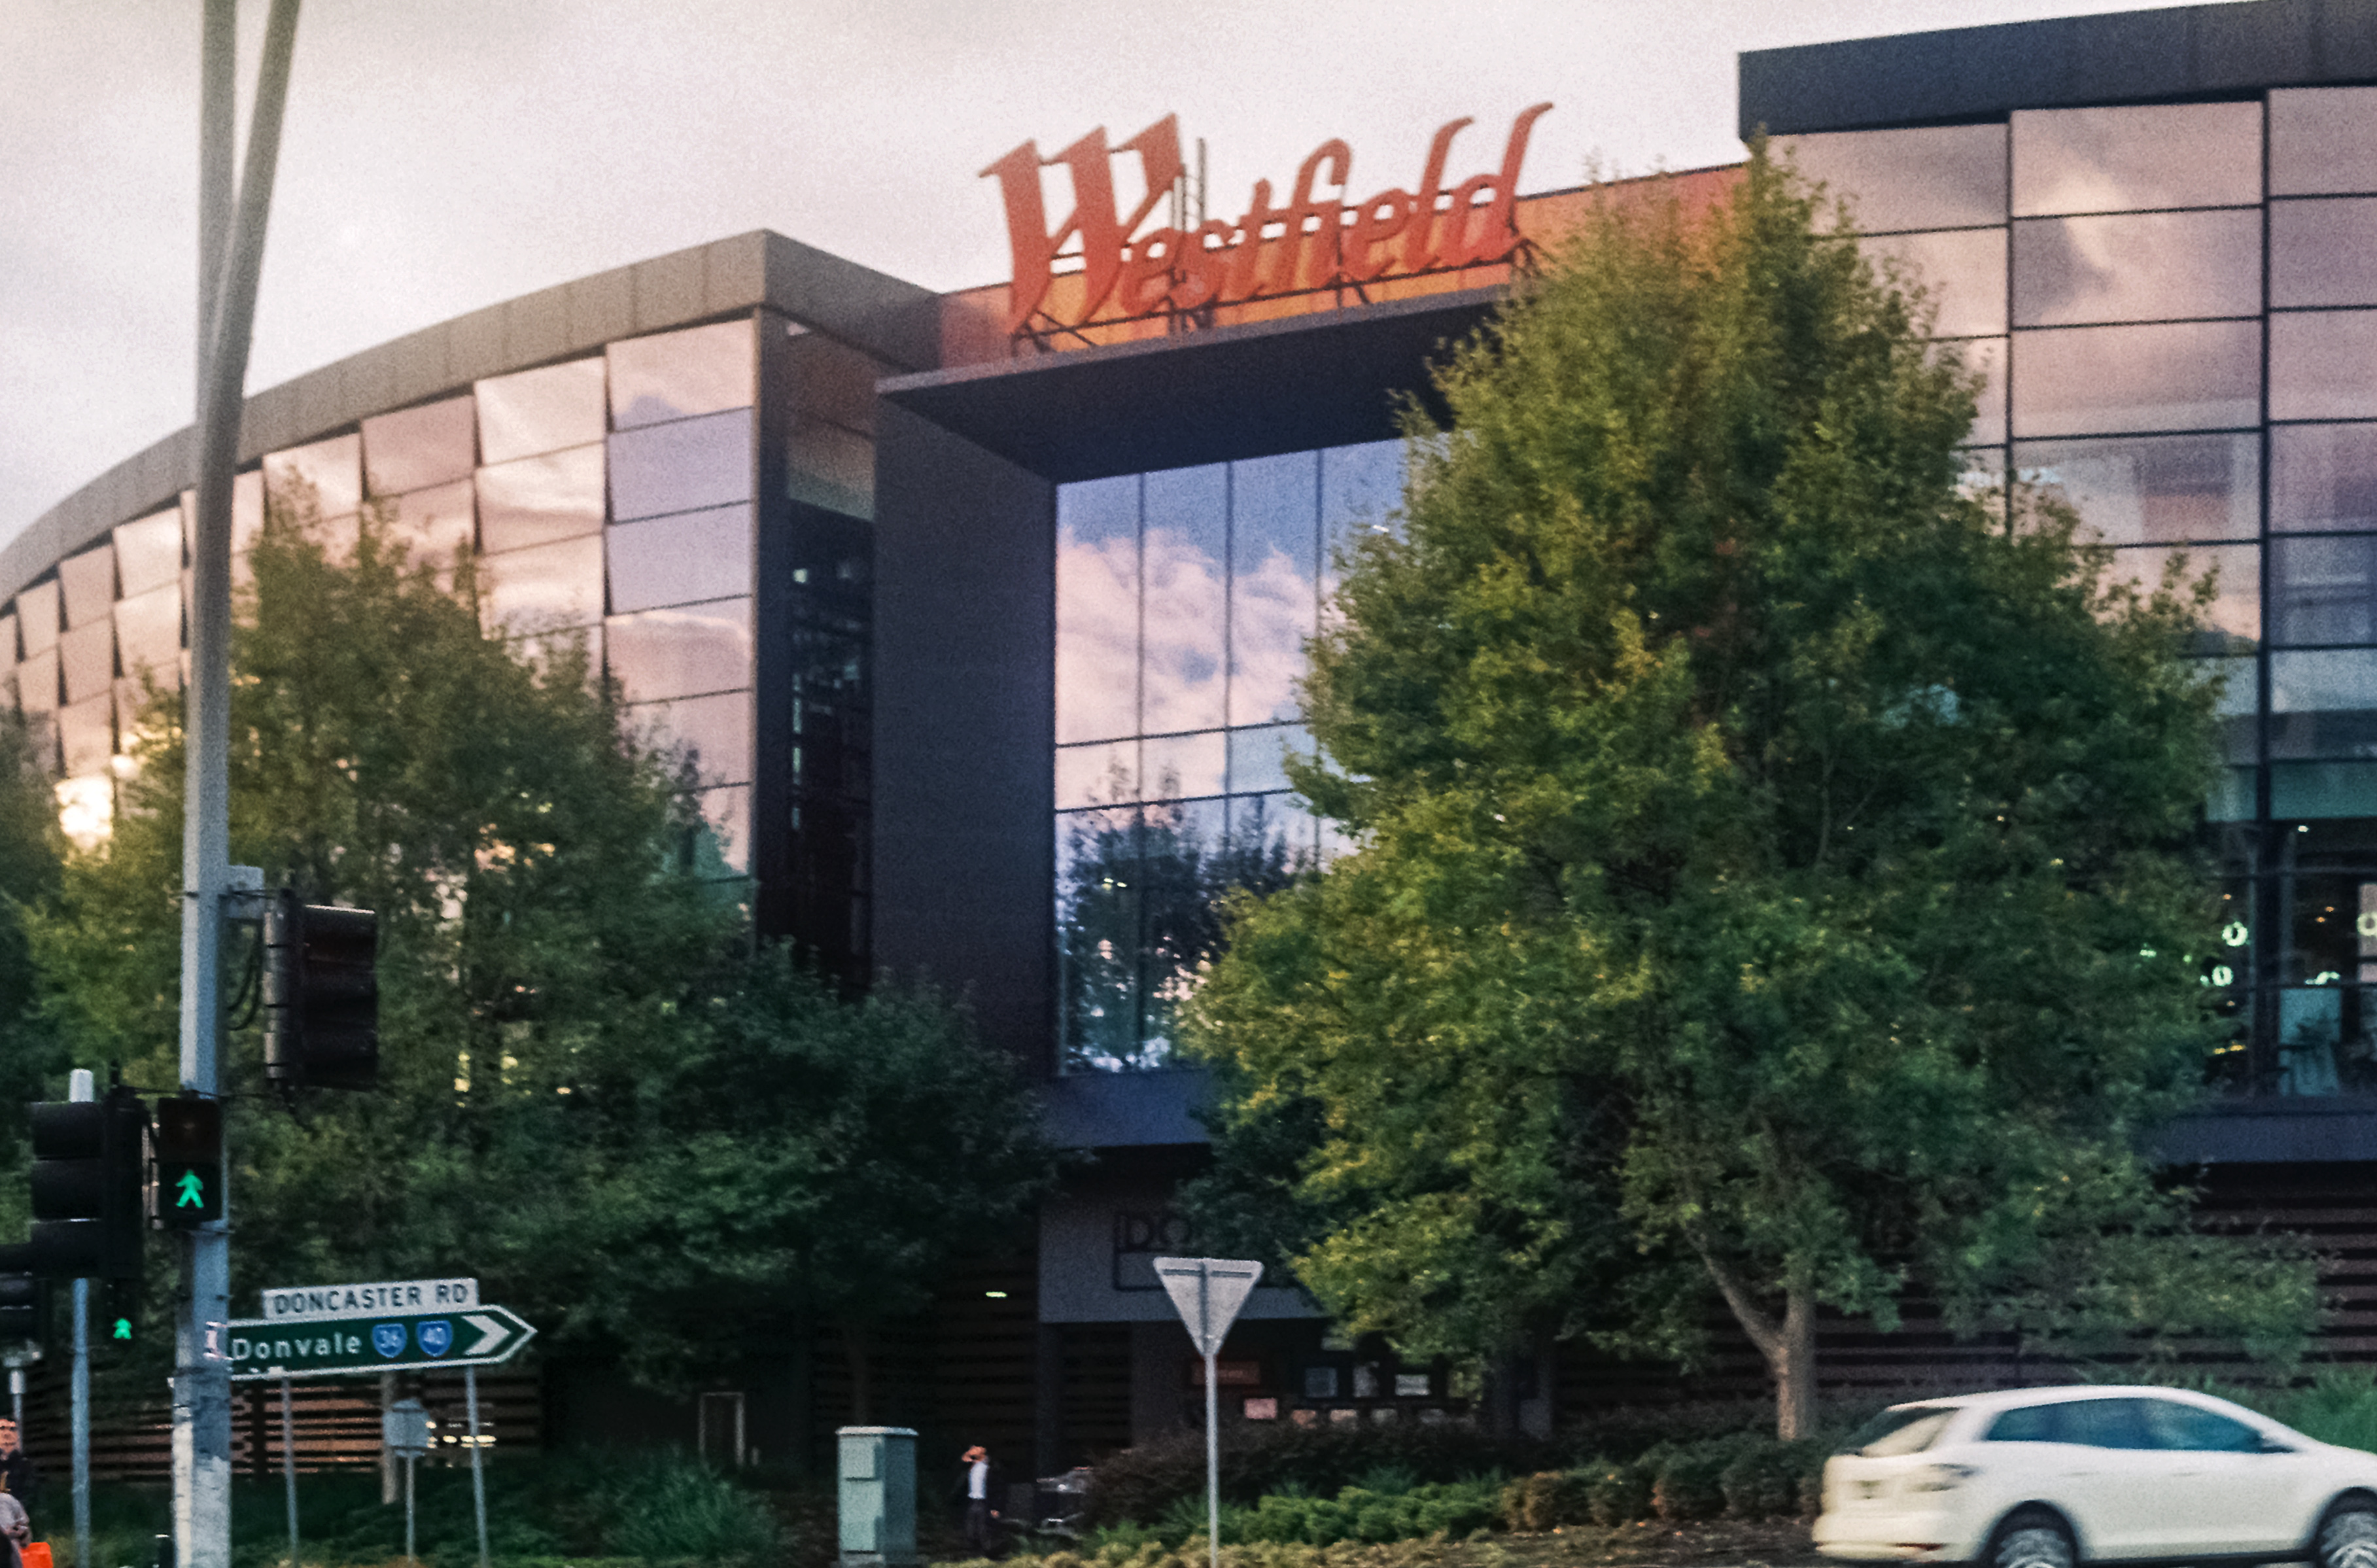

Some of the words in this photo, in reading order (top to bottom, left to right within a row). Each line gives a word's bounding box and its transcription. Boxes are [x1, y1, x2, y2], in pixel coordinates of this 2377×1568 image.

[979, 101, 1553, 334] Westfield
[274, 1285, 422, 1315] DONCASTER
[435, 1283, 469, 1304] RD
[232, 1331, 362, 1361] Donvale
